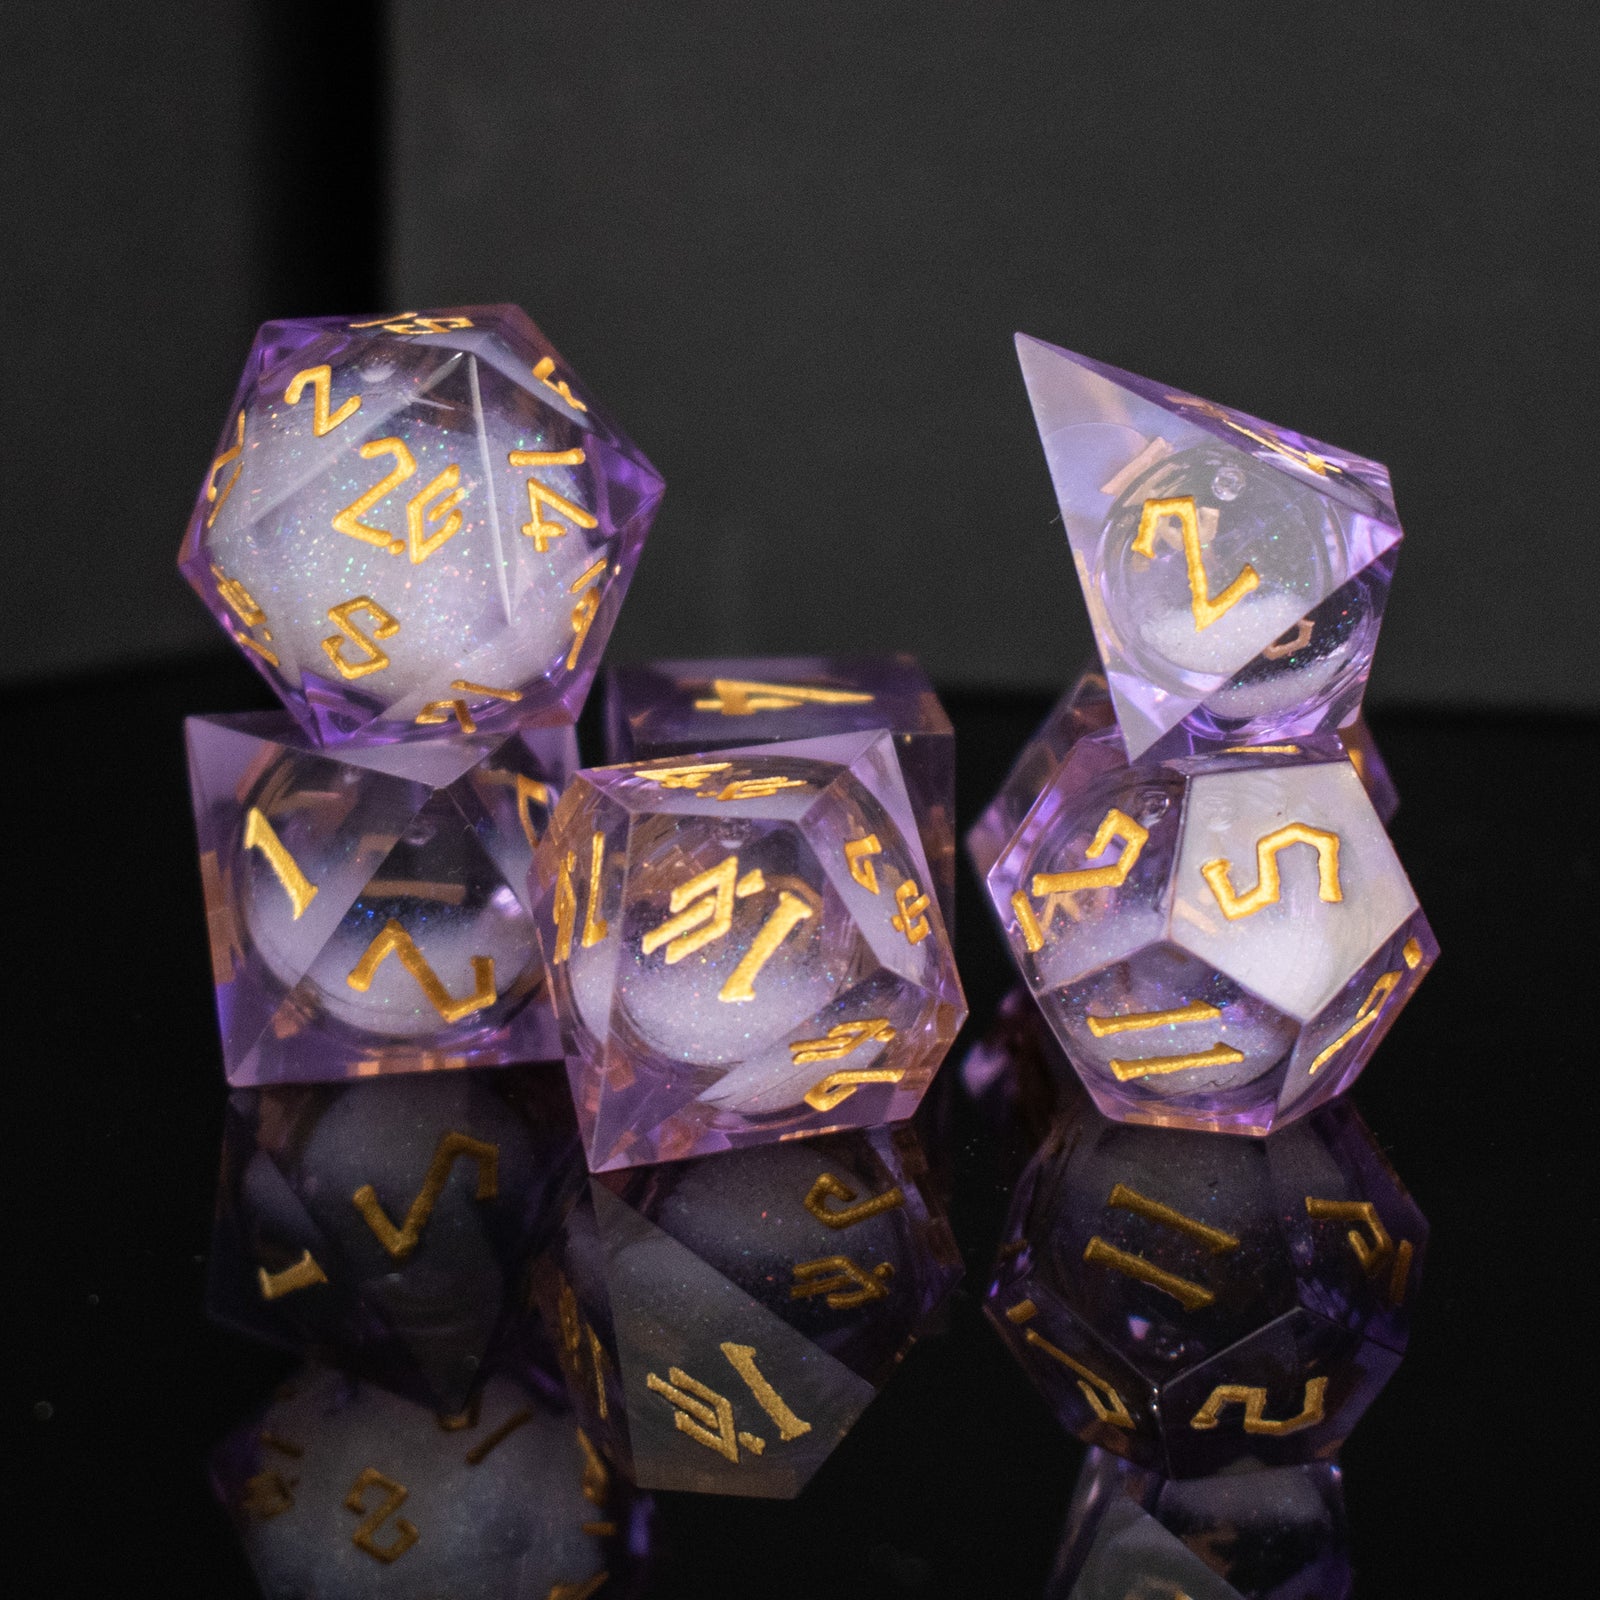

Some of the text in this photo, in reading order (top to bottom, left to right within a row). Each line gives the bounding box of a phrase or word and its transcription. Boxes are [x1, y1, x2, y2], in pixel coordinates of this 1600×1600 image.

[284, 364, 362, 438] 2
[507, 447, 599, 553] 14
[1131, 495, 1262, 633] 2
[244, 805, 320, 920] 1
